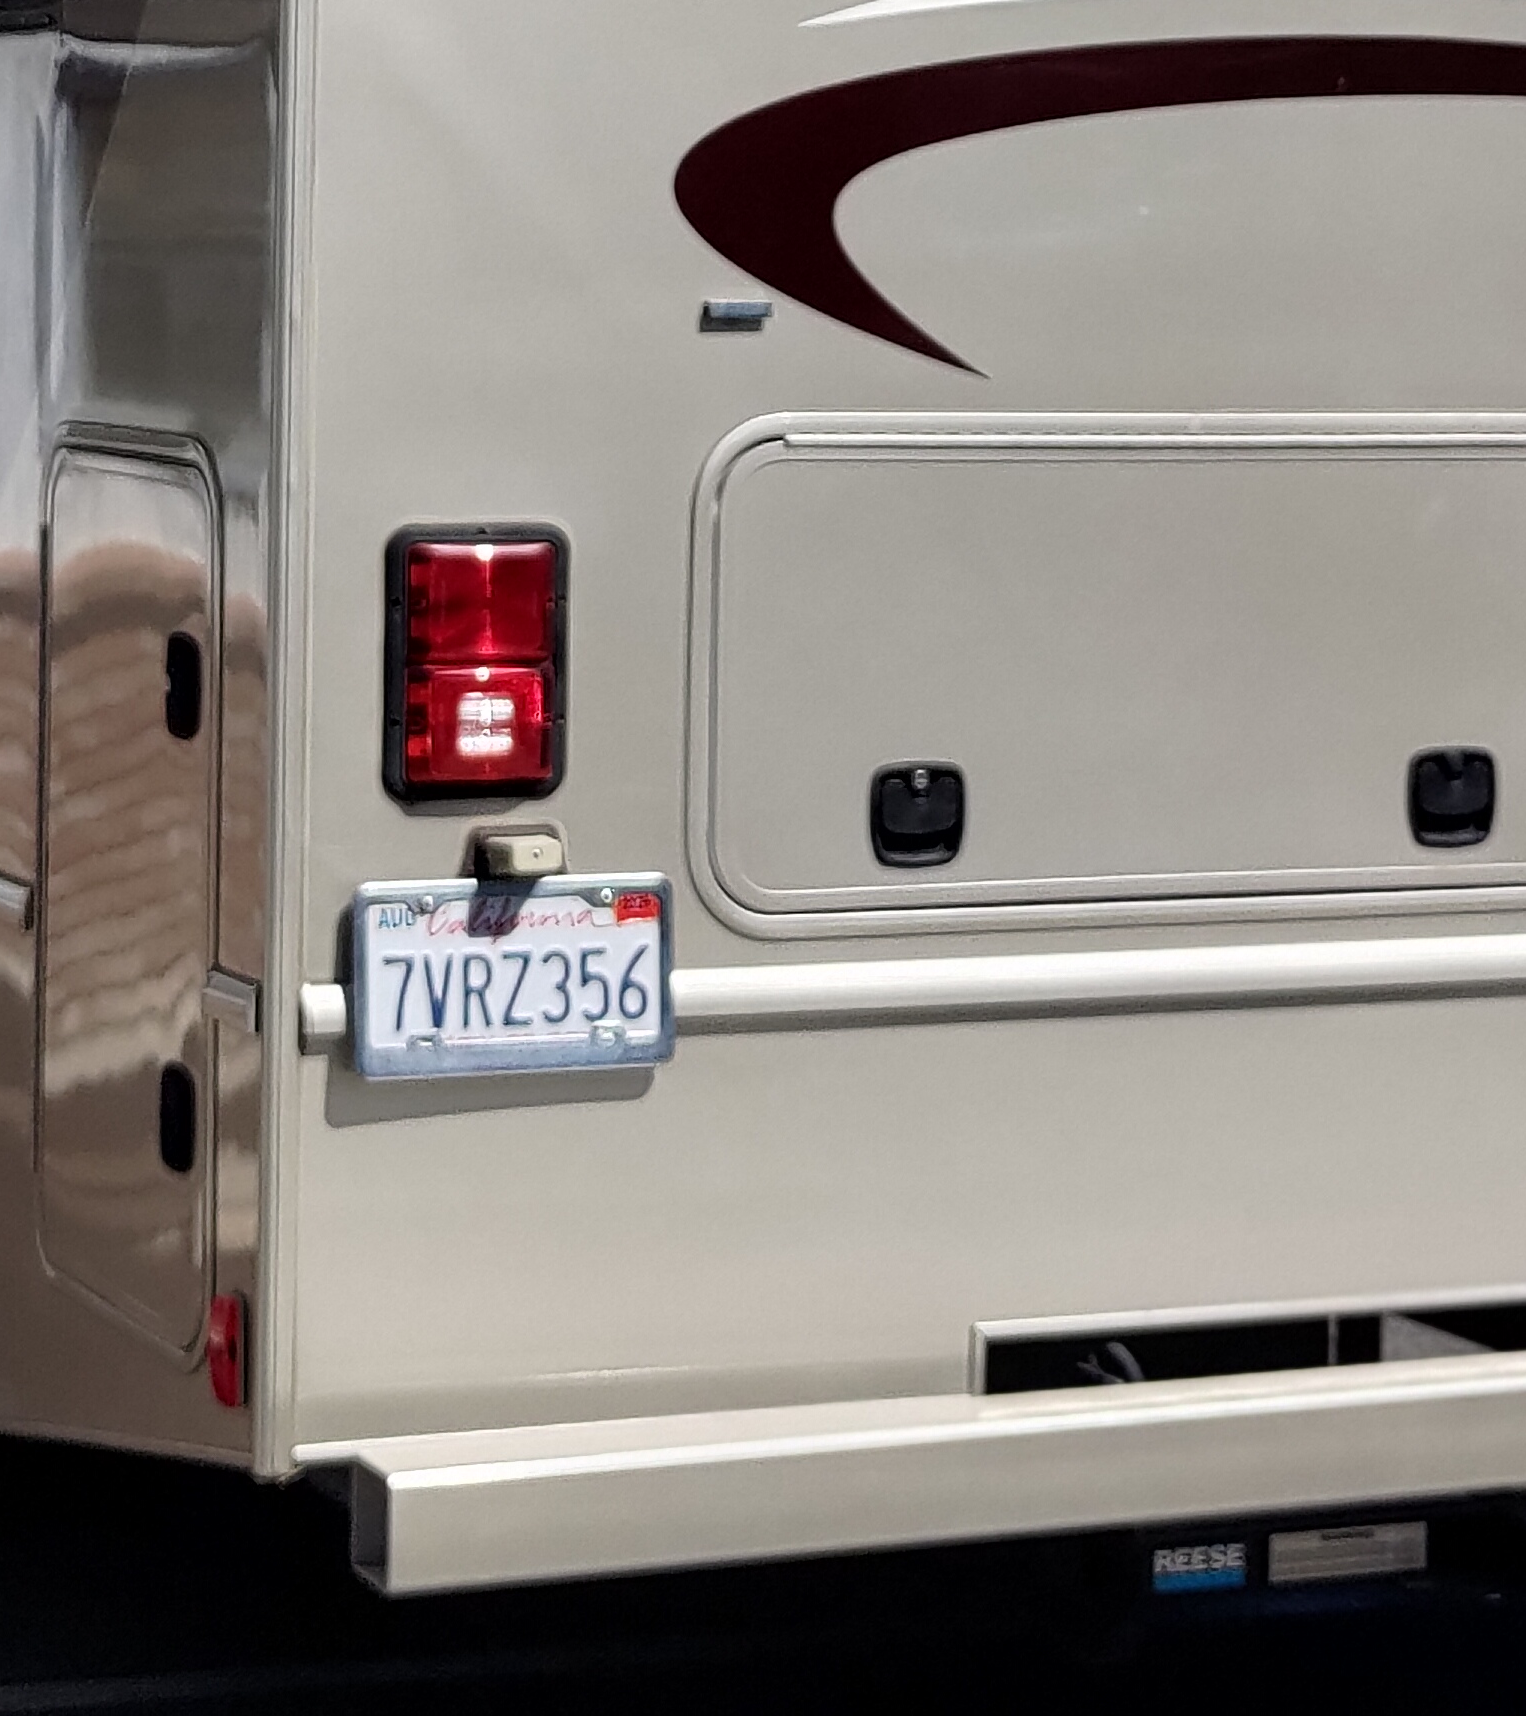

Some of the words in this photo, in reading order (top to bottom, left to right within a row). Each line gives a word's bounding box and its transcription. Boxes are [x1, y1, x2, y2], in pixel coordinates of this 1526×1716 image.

[426, 896, 612, 944] California
[382, 944, 651, 1032] 7VRZ356
[1153, 1542, 1247, 1574] REESE
